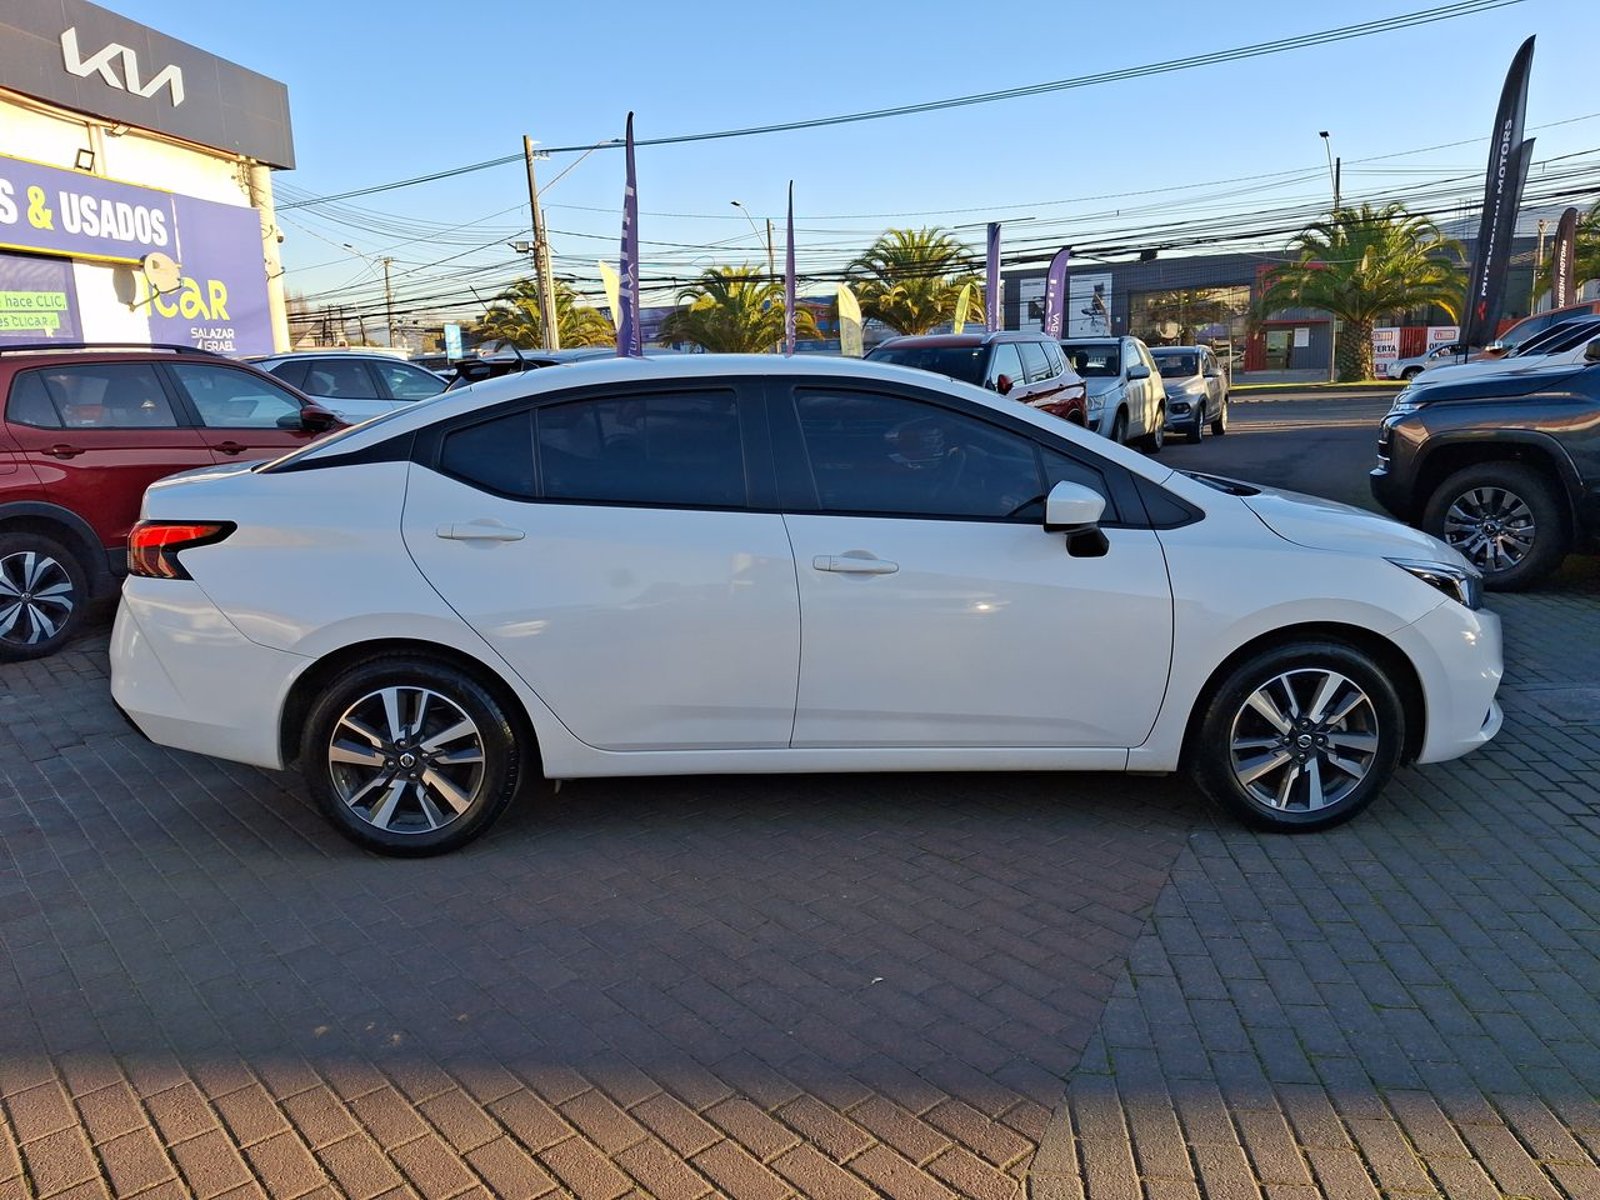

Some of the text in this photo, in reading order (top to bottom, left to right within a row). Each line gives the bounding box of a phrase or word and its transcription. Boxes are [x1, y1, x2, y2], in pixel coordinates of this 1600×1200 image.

[60, 26, 185, 108] KIA
[1497, 119, 1513, 194] MOTORS
[27, 185, 54, 230] &
[59, 190, 168, 247] USADOS
[5, 295, 32, 307] hace
[191, 327, 235, 339] SALAZAR
[204, 339, 236, 352] ISRAEL
